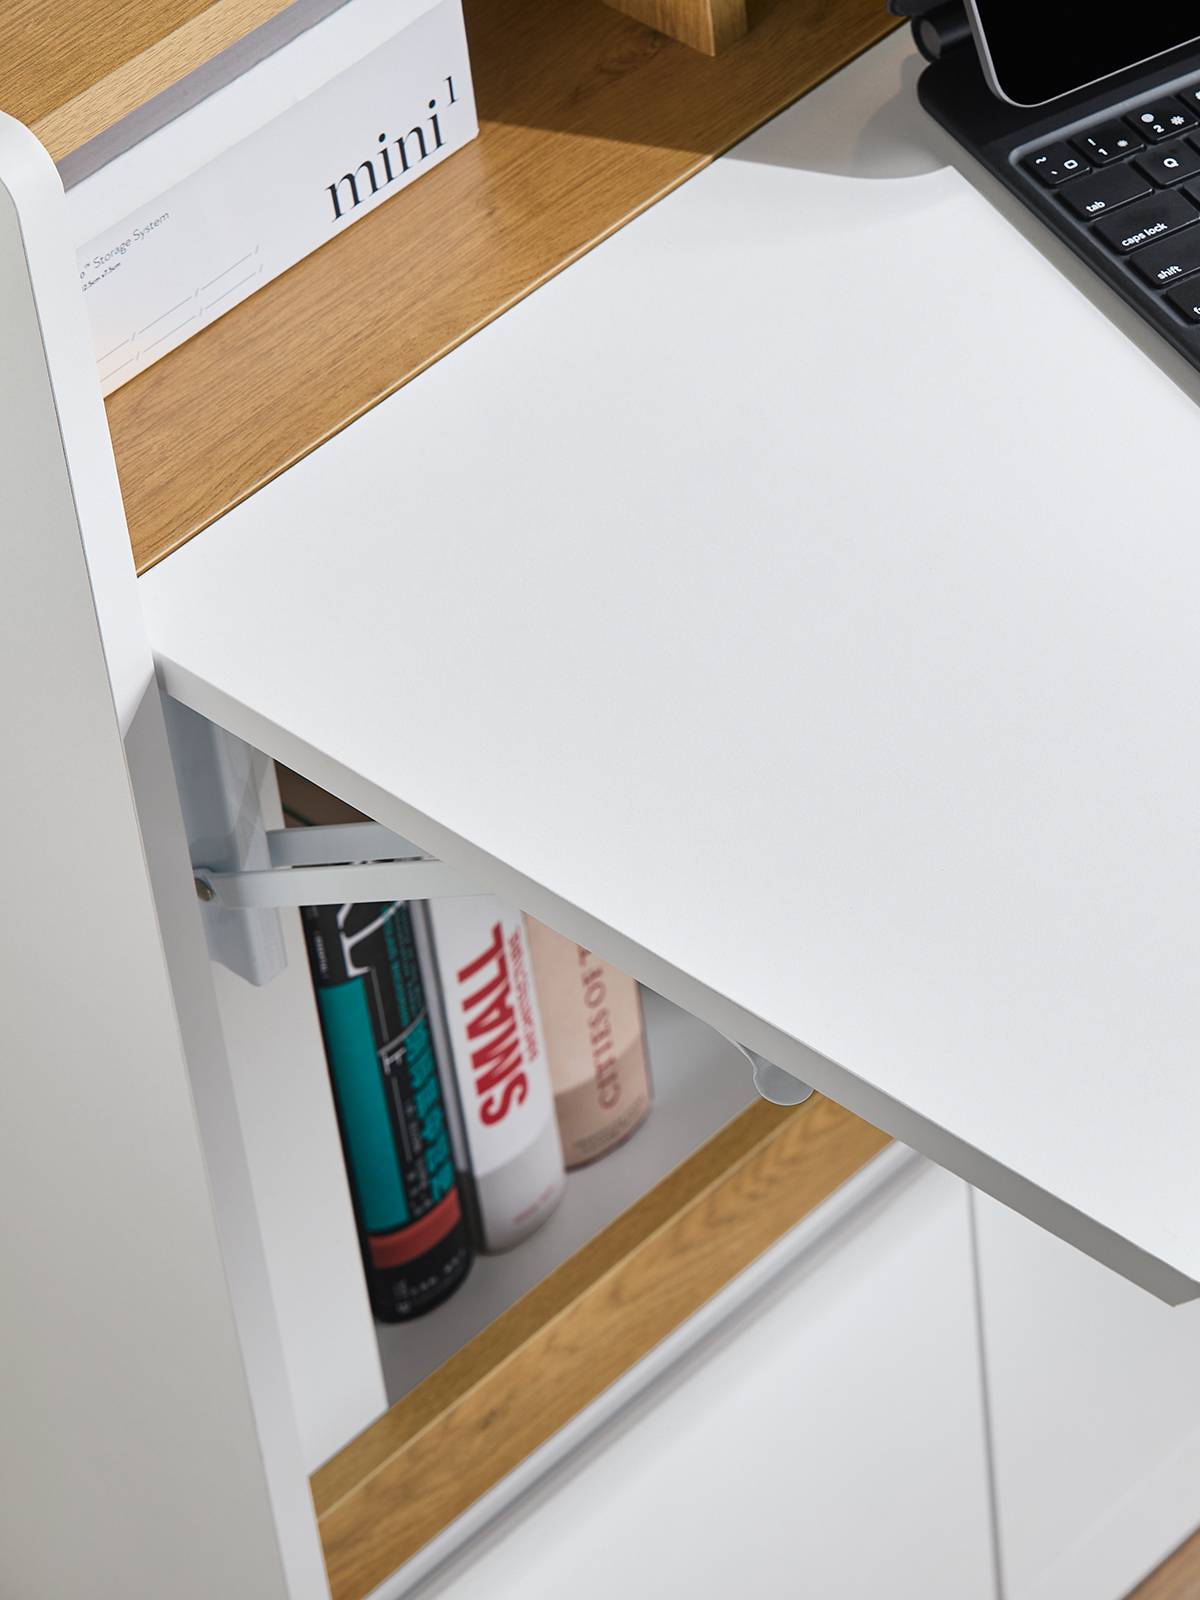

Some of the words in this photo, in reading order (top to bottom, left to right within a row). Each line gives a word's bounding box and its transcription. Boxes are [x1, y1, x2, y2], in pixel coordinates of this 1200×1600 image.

[1152, 124, 1165, 133] 2
[324, 99, 447, 223] mini
[1163, 157, 1179, 168] Q
[1085, 201, 1106, 212] tab
[92, 239, 132, 269] Storage
[132, 212, 170, 241] System
[1121, 232, 1147, 247] caps
[1143, 222, 1168, 236] lock
[1157, 265, 1183, 280] shift
[457, 919, 529, 1127] SMALL
[586, 1007, 622, 1111] CITIES
